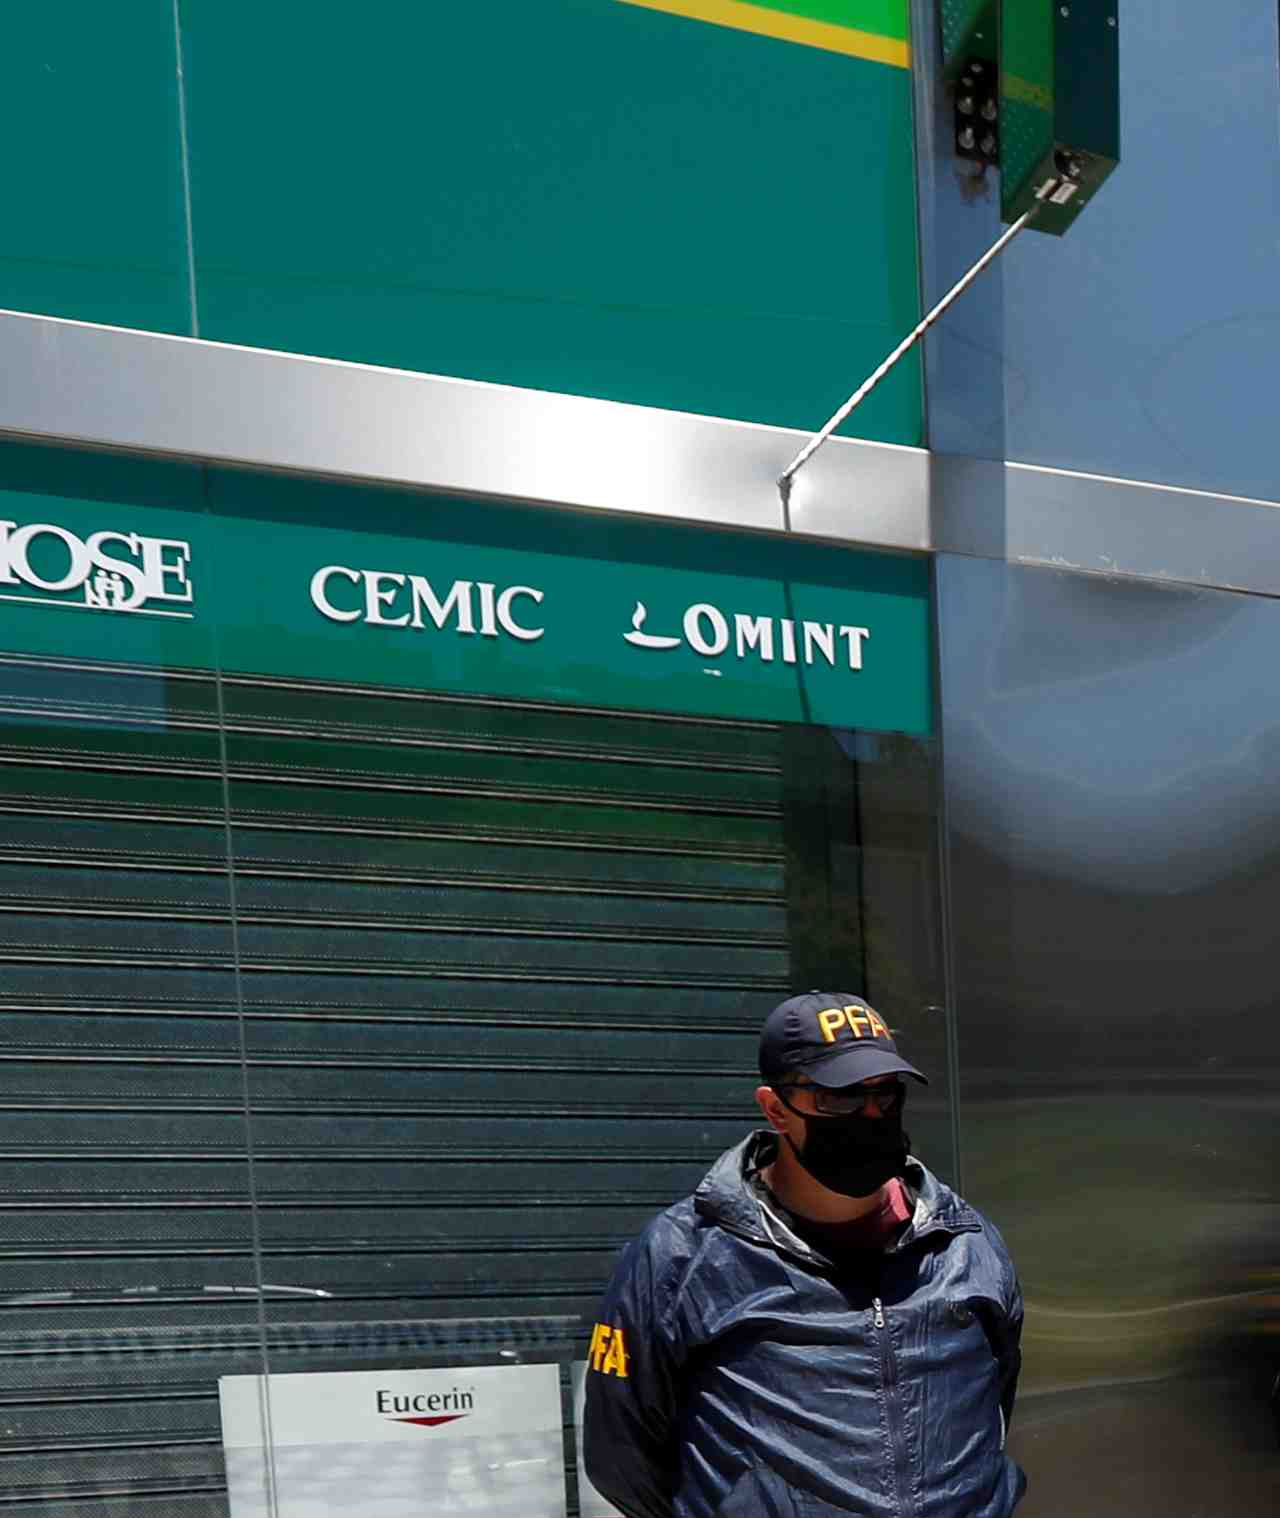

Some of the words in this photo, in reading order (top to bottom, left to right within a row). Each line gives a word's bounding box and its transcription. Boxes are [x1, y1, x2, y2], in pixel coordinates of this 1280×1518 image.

[309, 565, 545, 641] CEMIC
[682, 602, 871, 671] OMINT
[817, 1004, 893, 1043] PFA
[375, 1386, 474, 1414] Eucerin
